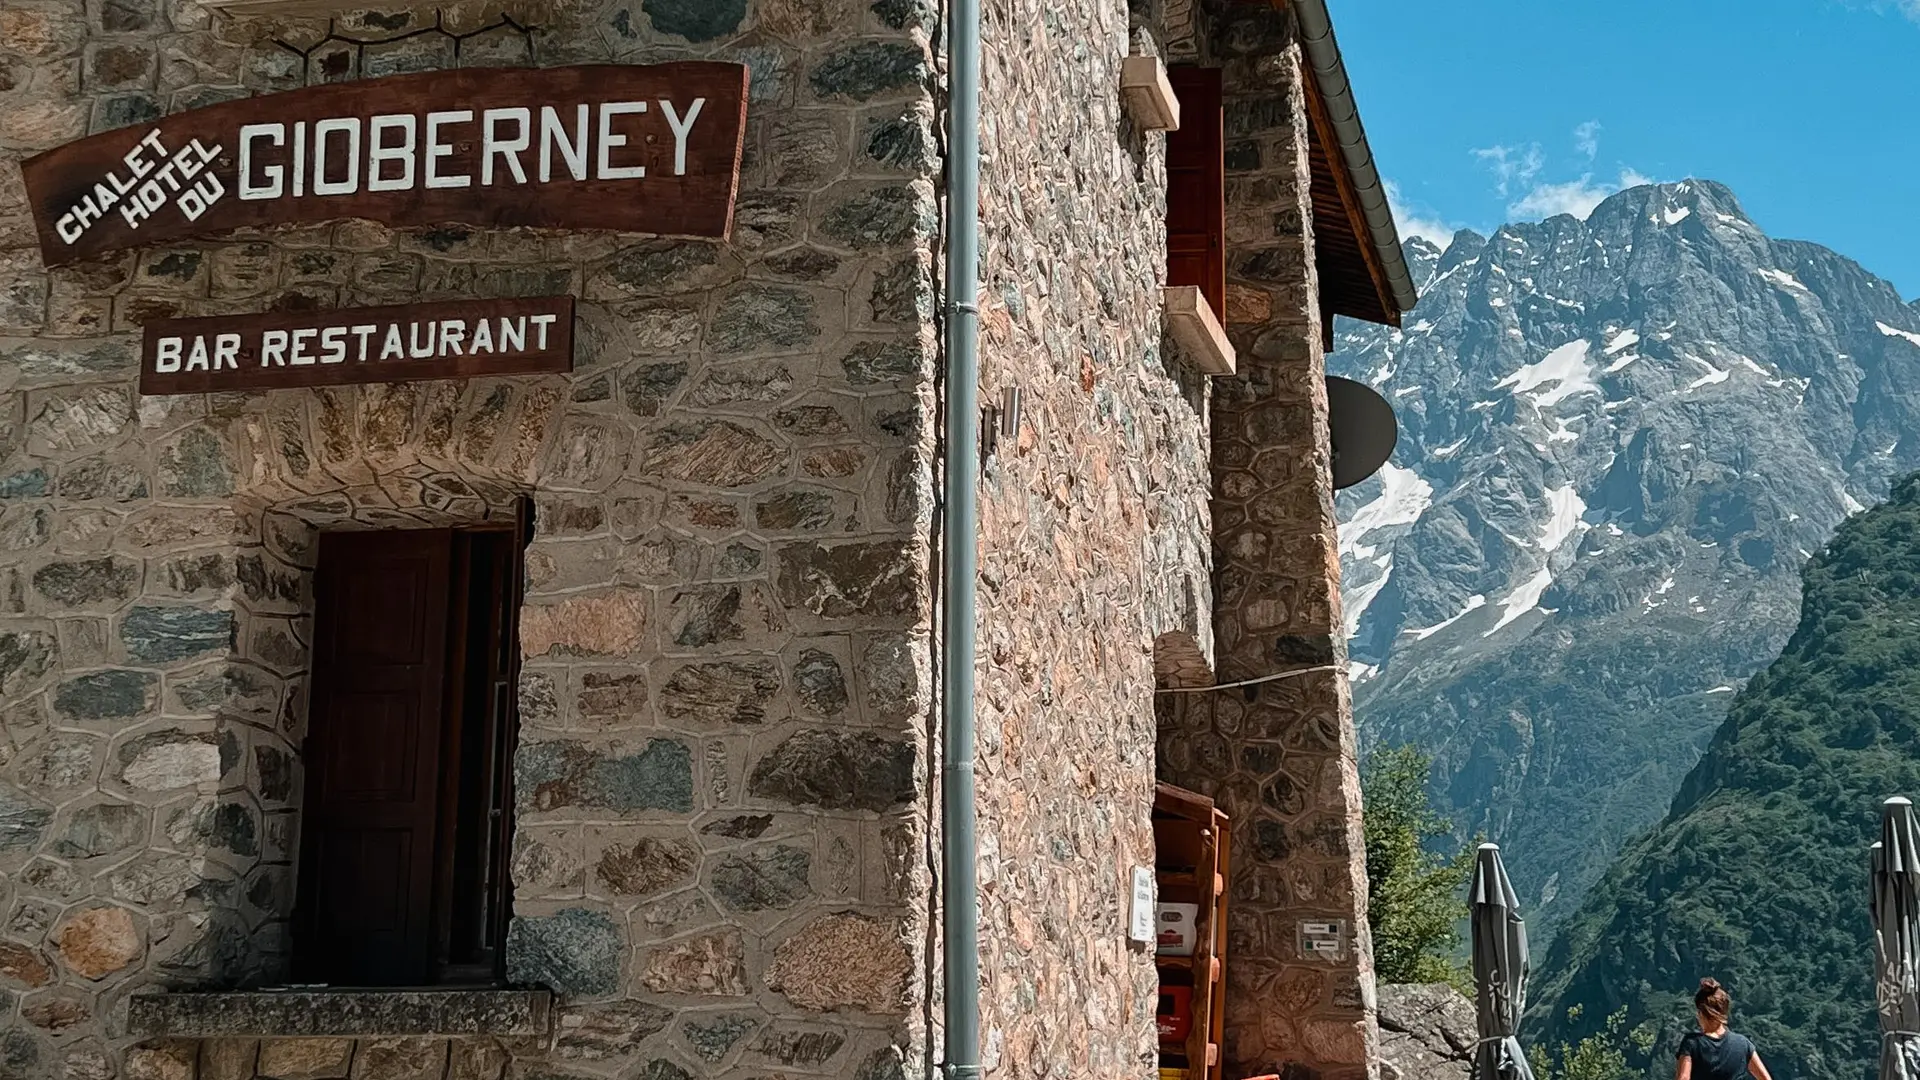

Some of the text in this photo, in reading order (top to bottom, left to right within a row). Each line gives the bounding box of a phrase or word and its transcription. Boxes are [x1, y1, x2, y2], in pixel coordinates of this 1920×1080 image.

[56, 128, 167, 245] CHALET
[120, 138, 223, 230] HOTEL
[238, 97, 706, 201] GIOBERNEY
[176, 171, 225, 222] DU
[155, 314, 557, 373] BAR RESTAURANT
